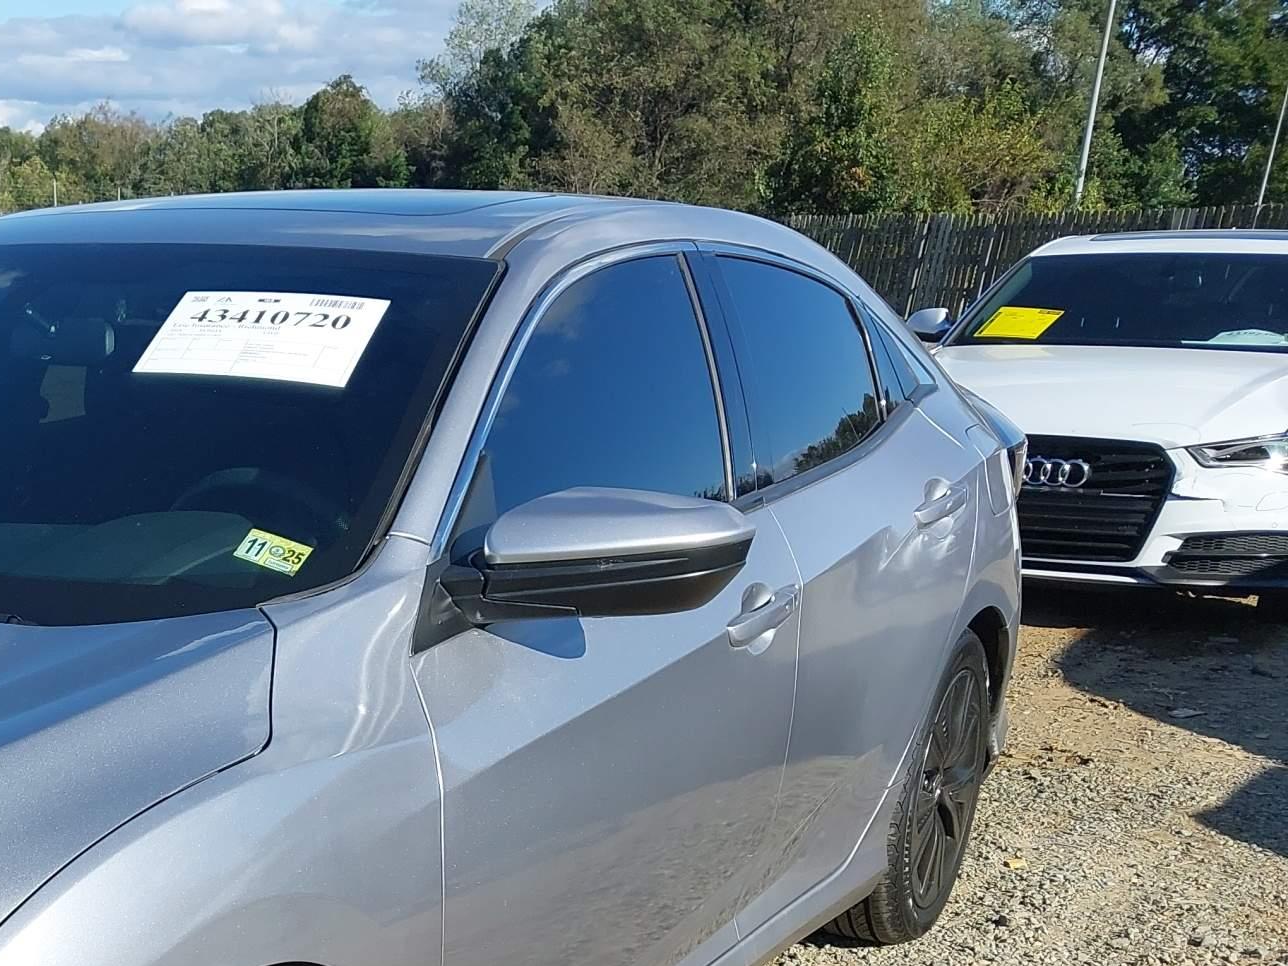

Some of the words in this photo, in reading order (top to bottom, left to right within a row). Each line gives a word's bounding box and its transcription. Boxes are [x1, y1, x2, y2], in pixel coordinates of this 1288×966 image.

[189, 308, 352, 330] 43410720
[245, 537, 268, 557] 11
[282, 549, 305, 565] 25
